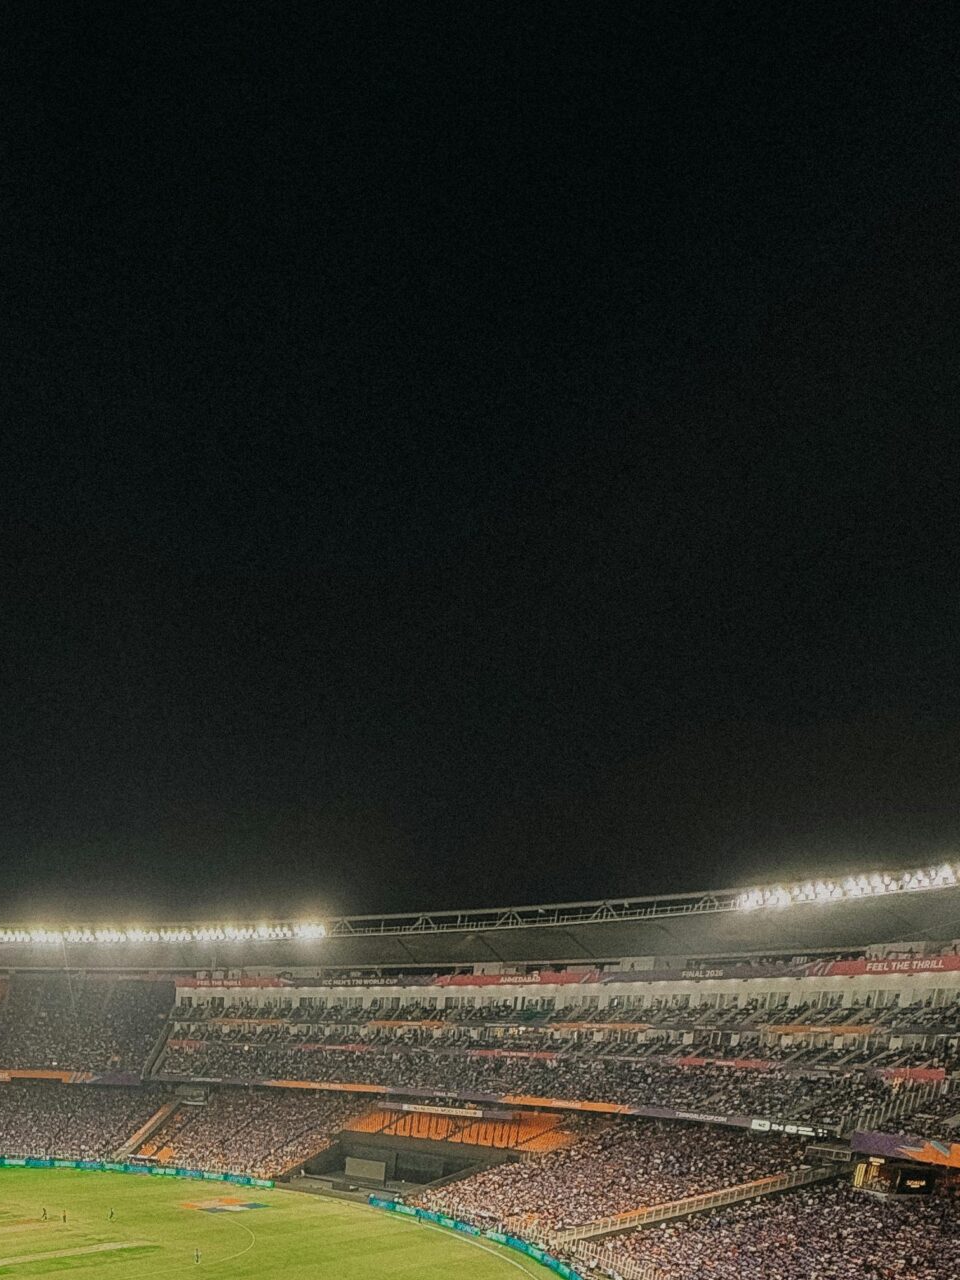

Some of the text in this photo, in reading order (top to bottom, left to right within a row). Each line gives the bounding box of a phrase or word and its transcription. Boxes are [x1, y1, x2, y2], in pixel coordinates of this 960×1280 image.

[866, 959, 944, 971] FEEL THE THRILL
[682, 970, 704, 978] FINAL
